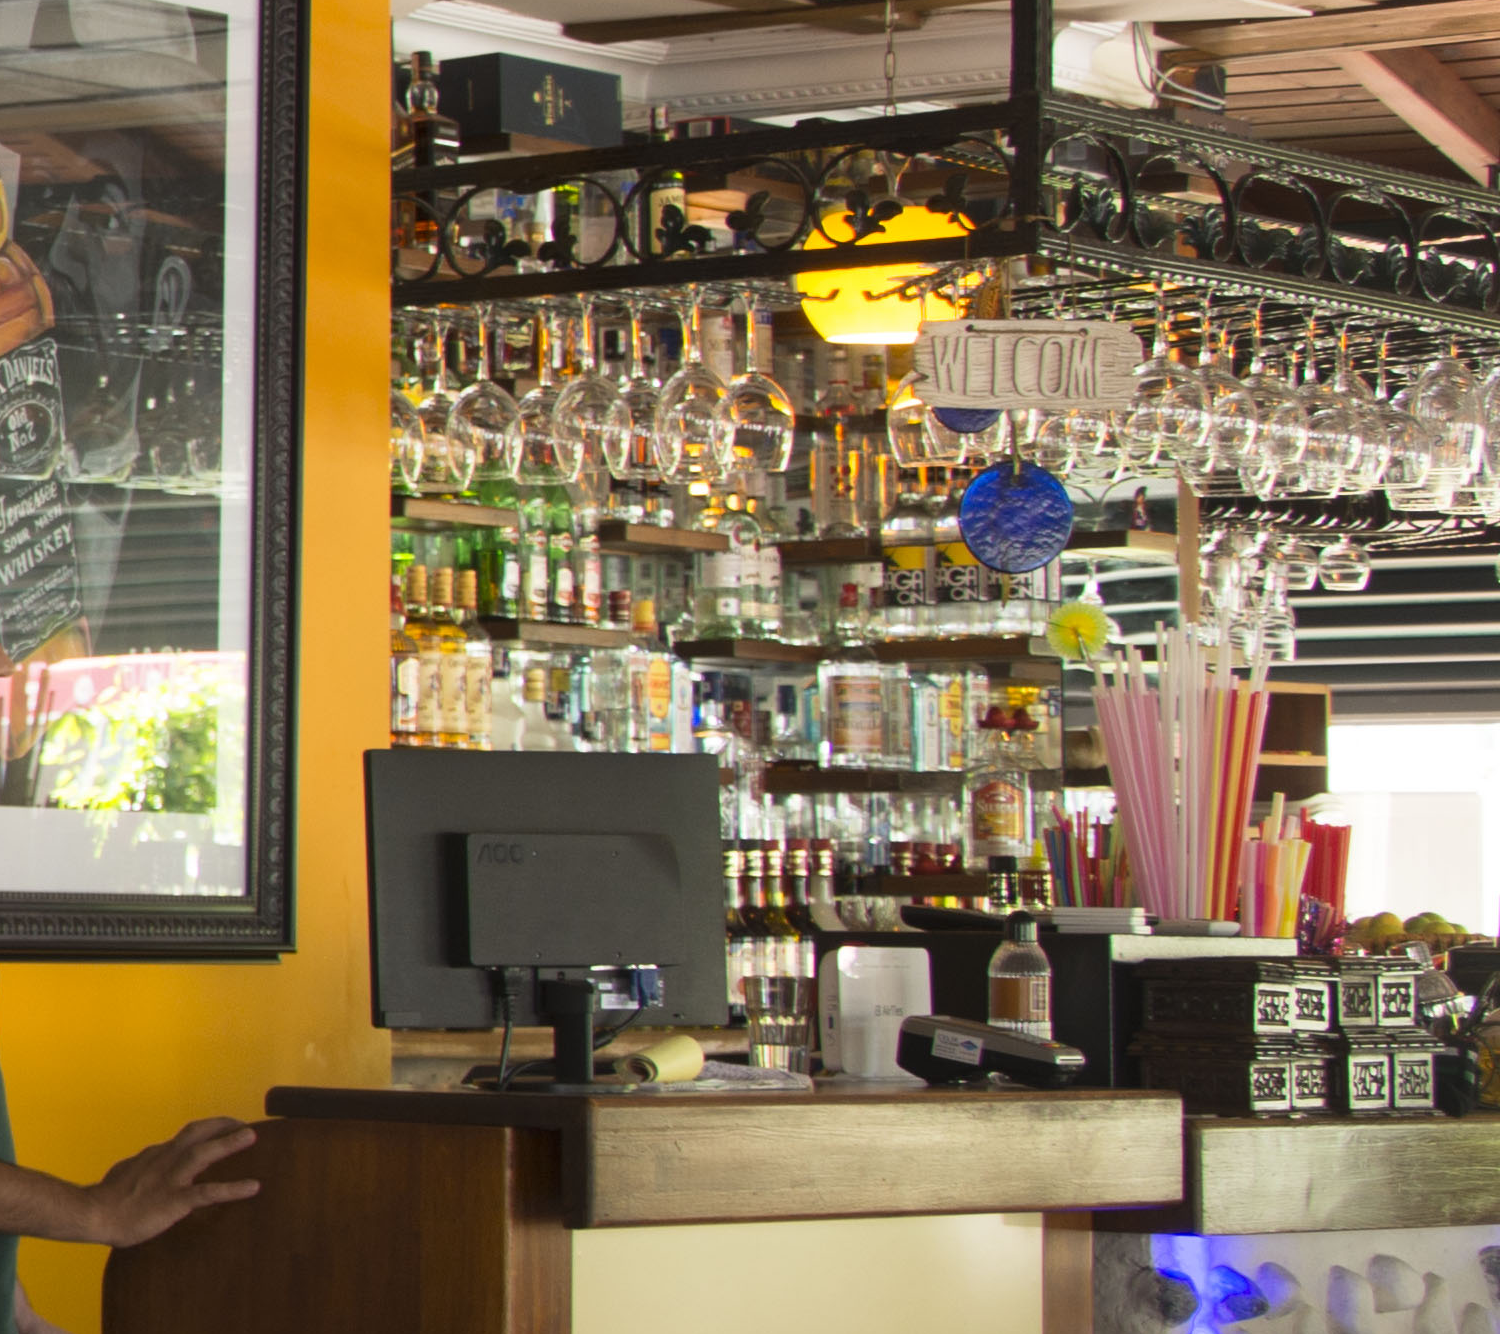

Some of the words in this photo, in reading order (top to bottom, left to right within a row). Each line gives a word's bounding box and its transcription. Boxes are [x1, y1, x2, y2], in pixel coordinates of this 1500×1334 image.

[932, 336, 1116, 398] WELCOME
[8, 407, 29, 431] Old
[4, 528, 31, 554] SOUR
